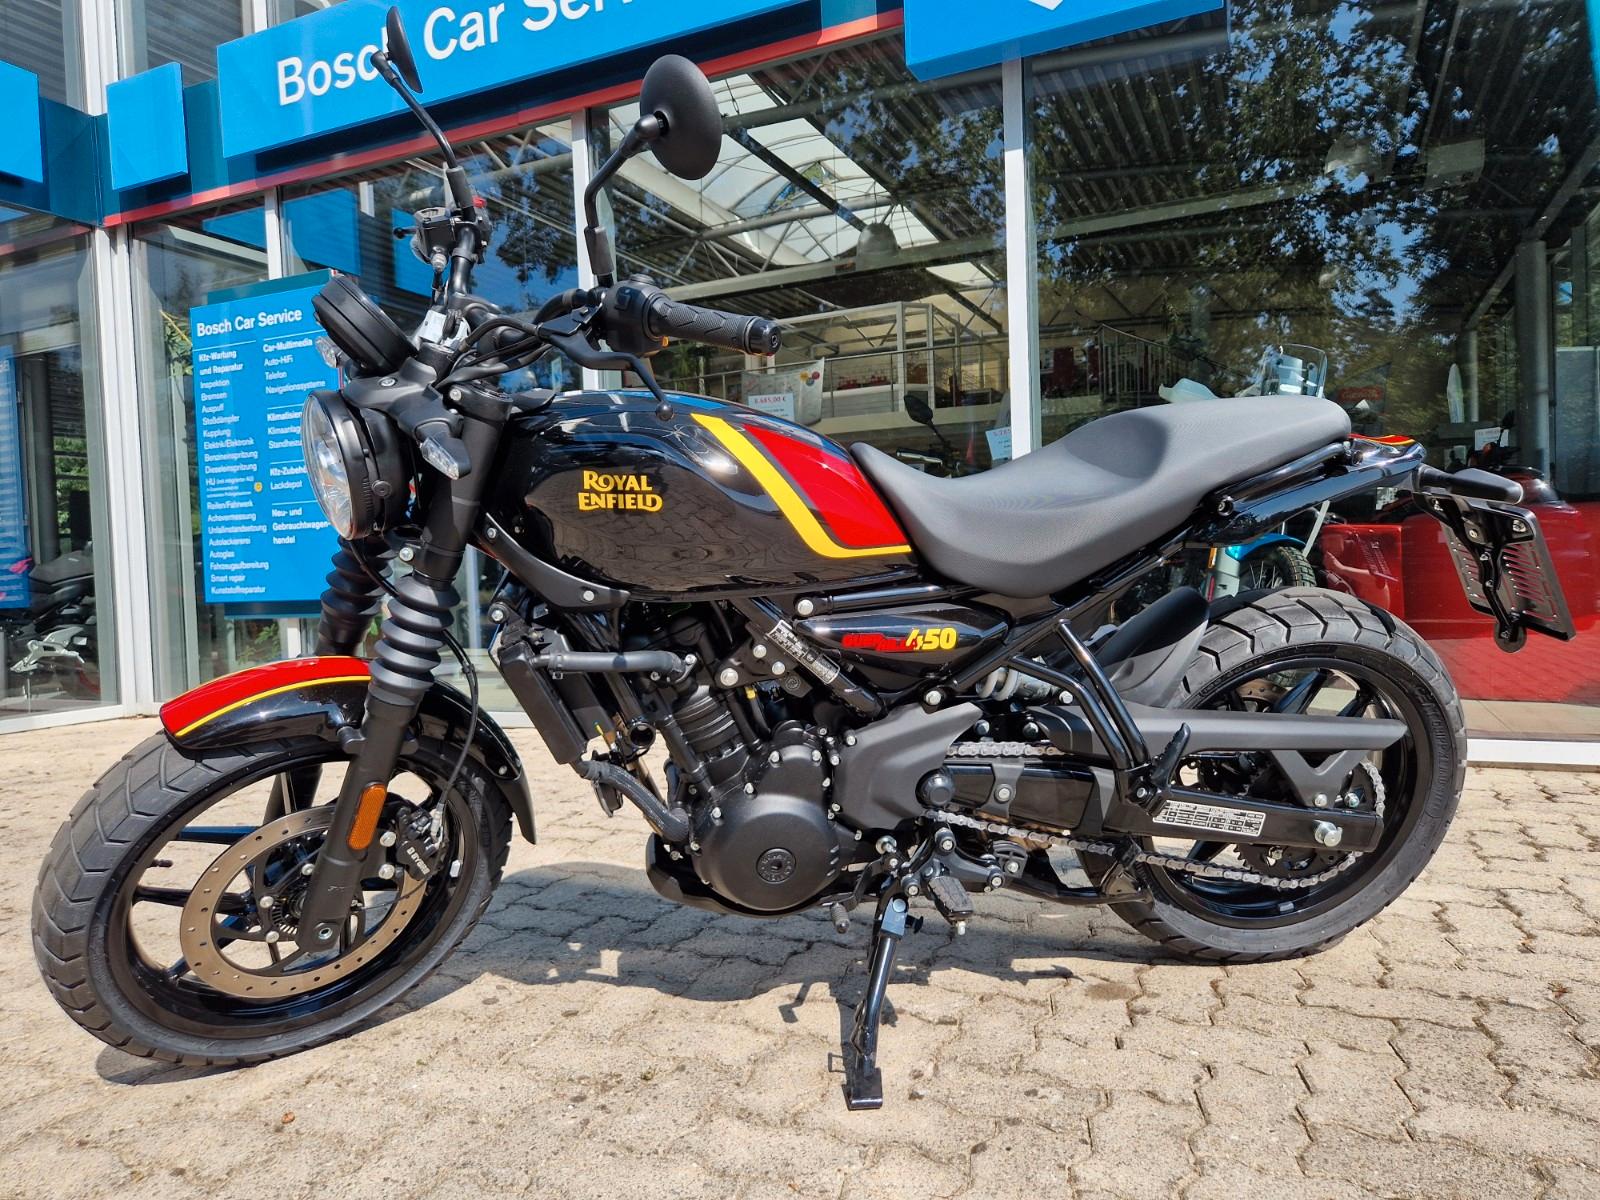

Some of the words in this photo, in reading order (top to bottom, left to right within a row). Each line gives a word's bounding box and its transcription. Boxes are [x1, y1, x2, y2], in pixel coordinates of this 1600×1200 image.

[423, 4, 505, 60] Car
[197, 318, 232, 337] Bosch
[235, 316, 255, 331] Car
[258, 308, 302, 327] Service
[263, 338, 313, 353] Car-Multimedia
[199, 350, 237, 362] Kfz-Wartung
[200, 365, 212, 375] und
[213, 363, 243, 376] Reparatur
[265, 370, 287, 380] Telefon
[200, 379, 230, 390] Inspektion
[266, 380, 326, 395] Navigationssysteme
[201, 391, 227, 402] Bremsen
[202, 403, 224, 414] Auspuff
[267, 410, 302, 422] Klimatisier
[203, 427, 231, 439] Kupplung
[268, 423, 301, 436] Klimaanlag
[268, 438, 302, 449] Standheizu
[270, 465, 308, 477] Kfz-Zubehö
[270, 480, 303, 491] Lackdepot
[583, 470, 653, 492] ROYAL
[578, 492, 663, 512] ENFIELD
[272, 509, 288, 518] Neu-
[289, 507, 303, 517] und
[272, 520, 331, 532] Gebrauchtwagen-
[273, 535, 296, 545] handel
[209, 550, 235, 560] Autoglas
[211, 574, 228, 583] Smart
[229, 573, 246, 584] repair
[906, 627, 957, 650] 450
